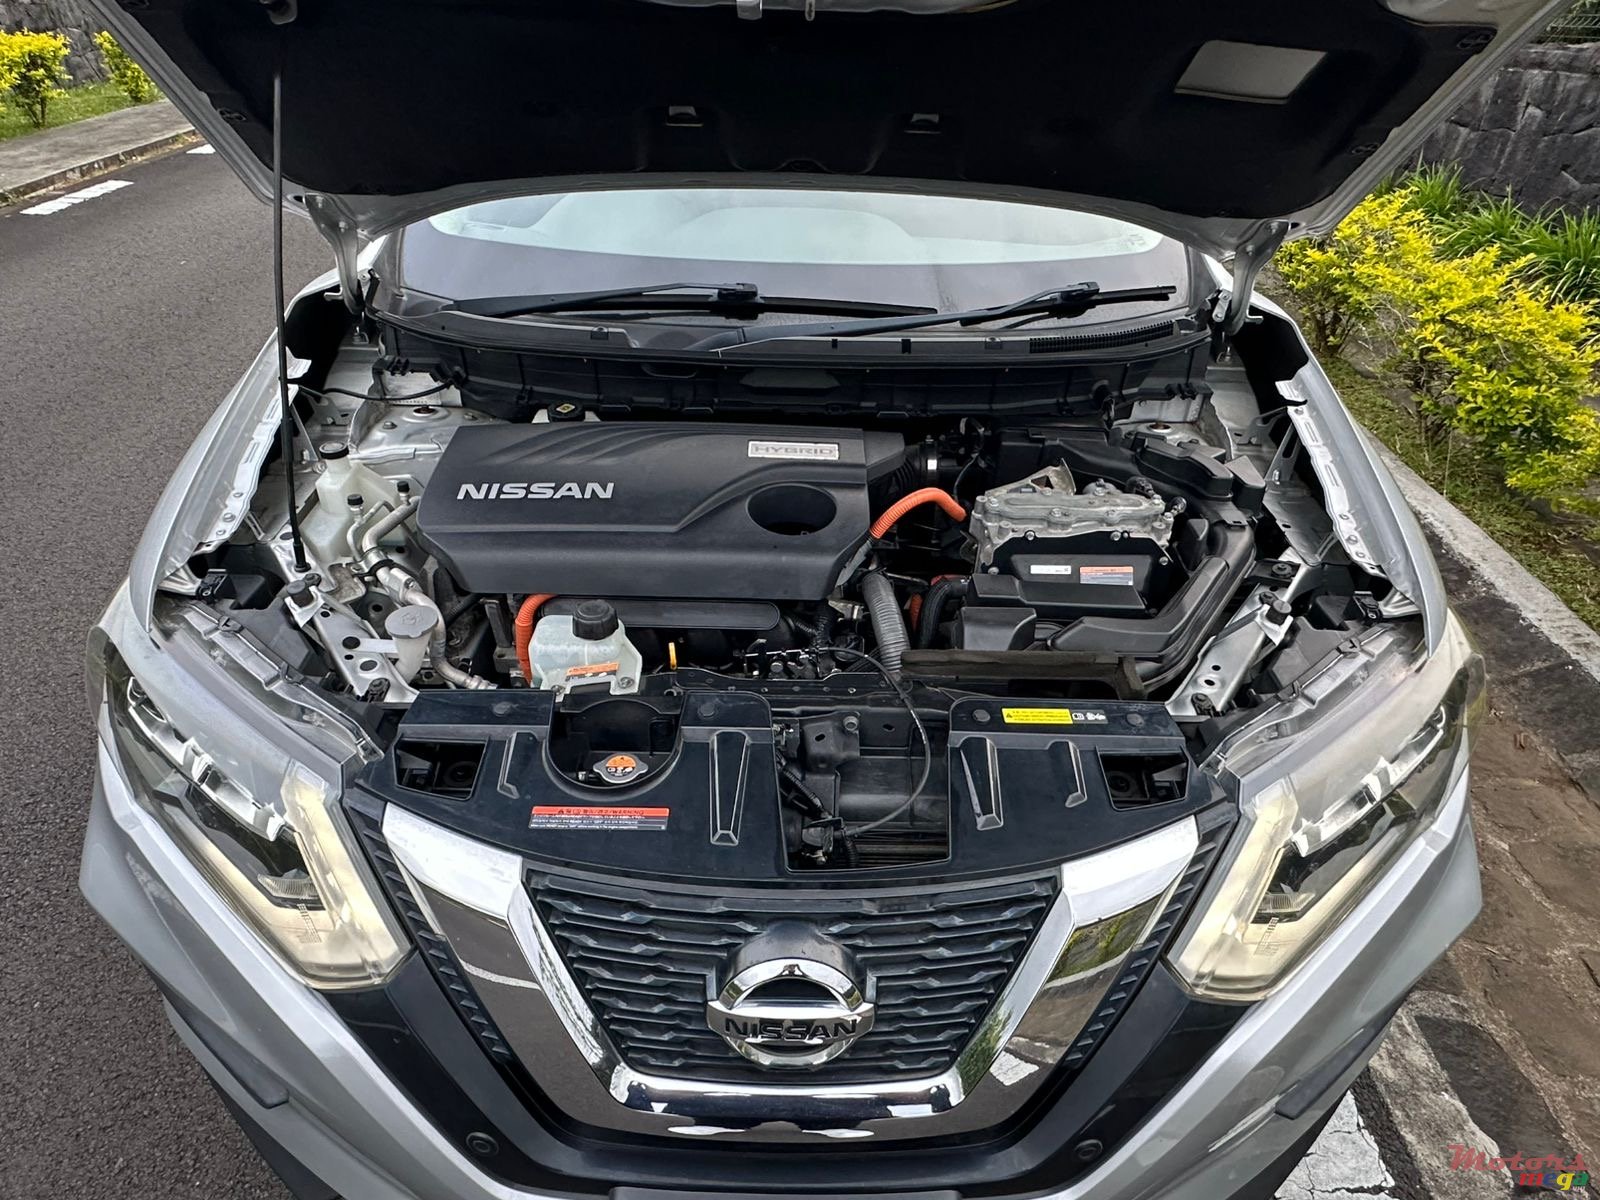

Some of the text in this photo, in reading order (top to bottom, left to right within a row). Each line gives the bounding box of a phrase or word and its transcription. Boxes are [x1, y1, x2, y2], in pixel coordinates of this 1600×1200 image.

[754, 446, 834, 456] HYBRID
[456, 482, 615, 500] NISSAN
[724, 1017, 858, 1040] NISSAN
